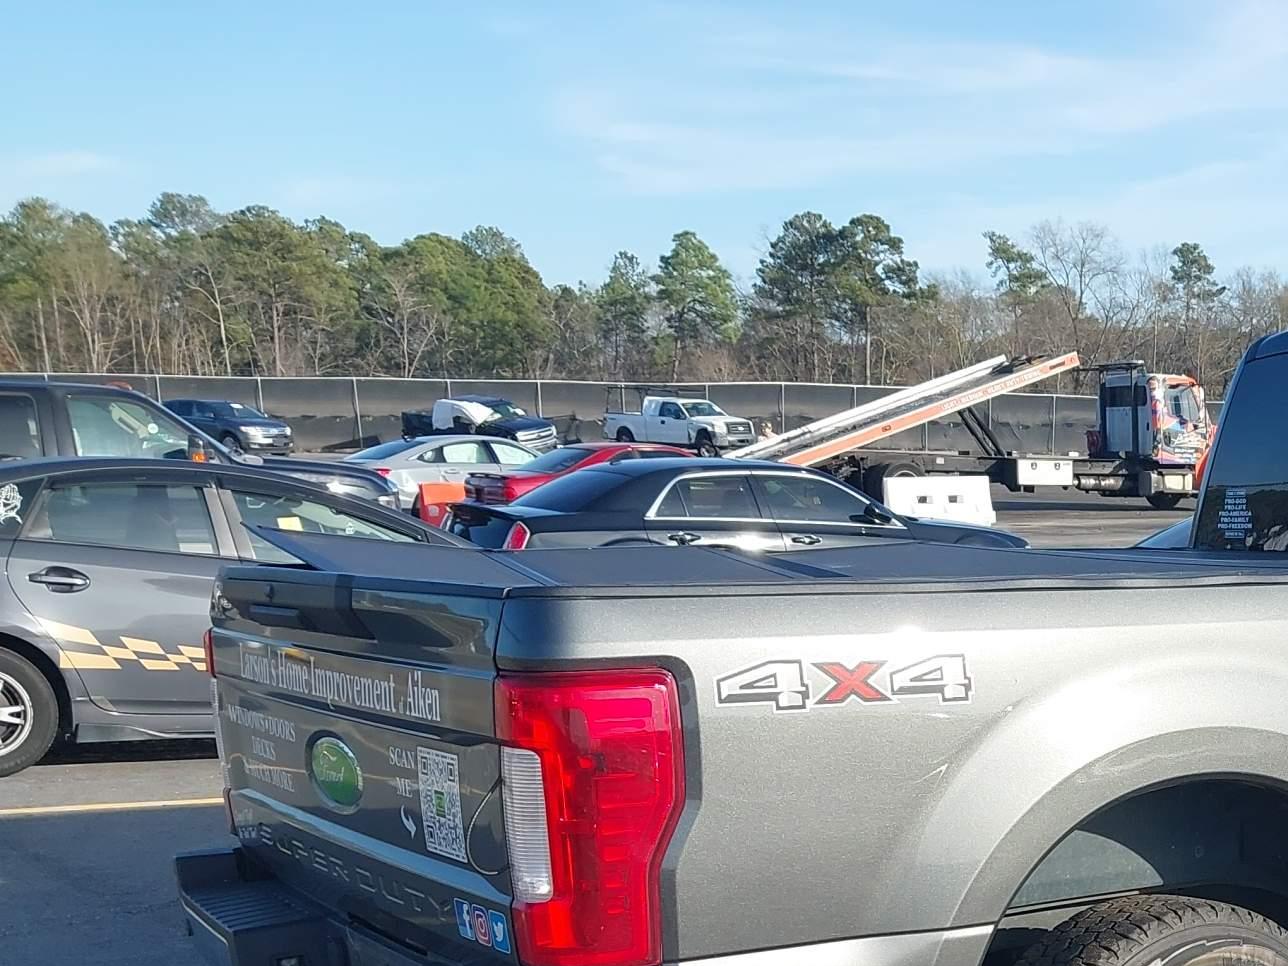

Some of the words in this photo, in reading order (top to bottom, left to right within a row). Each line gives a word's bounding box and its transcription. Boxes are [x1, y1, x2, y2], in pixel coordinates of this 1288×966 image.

[239, 642, 277, 687] Larson's
[278, 650, 309, 695] Home
[310, 656, 396, 714] Improvement
[405, 669, 441, 722] Aiken
[388, 745, 416, 770] SCAN
[395, 776, 413, 799] ME
[355, 867, 452, 922] DUTY
